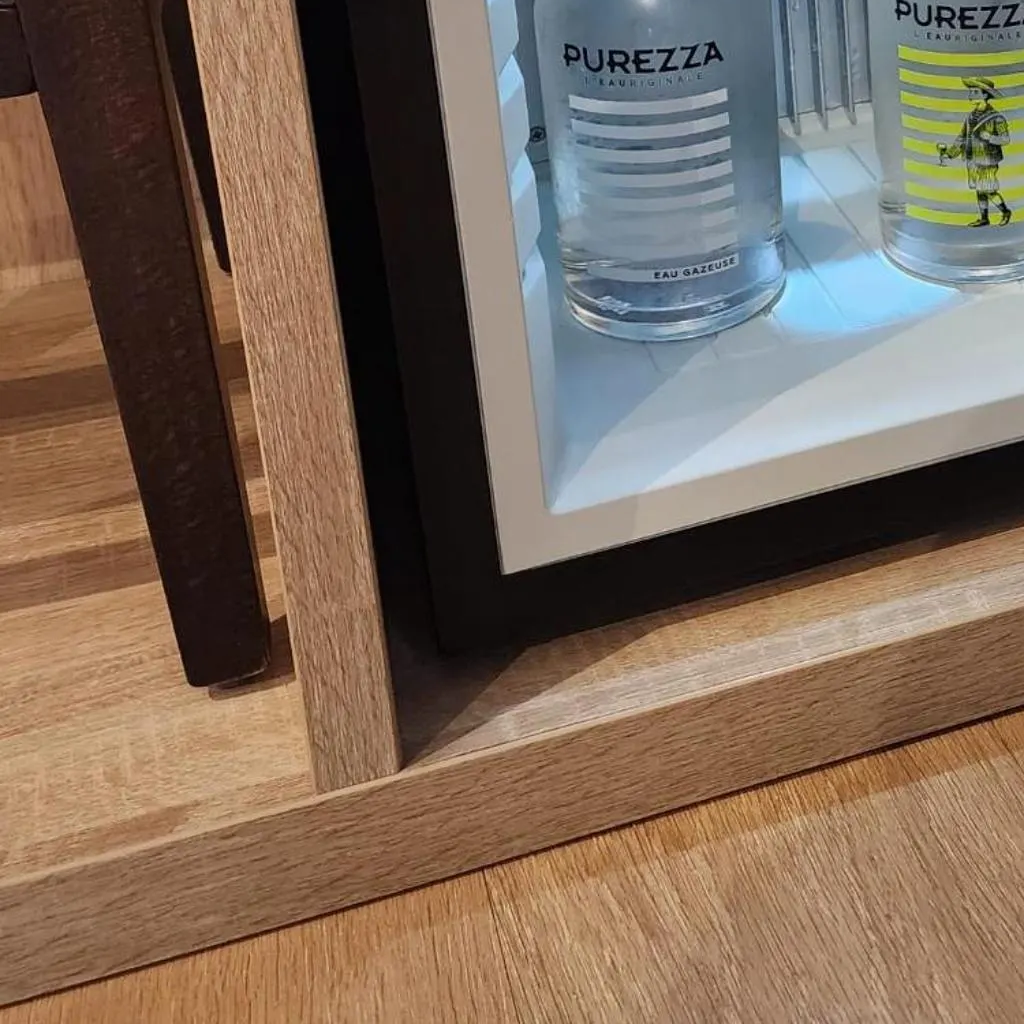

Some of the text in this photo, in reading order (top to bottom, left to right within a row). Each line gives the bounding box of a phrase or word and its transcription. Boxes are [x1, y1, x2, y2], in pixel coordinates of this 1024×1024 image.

[563, 40, 724, 74] PUREZZA
[653, 257, 737, 280] EAU GAZEUSE
